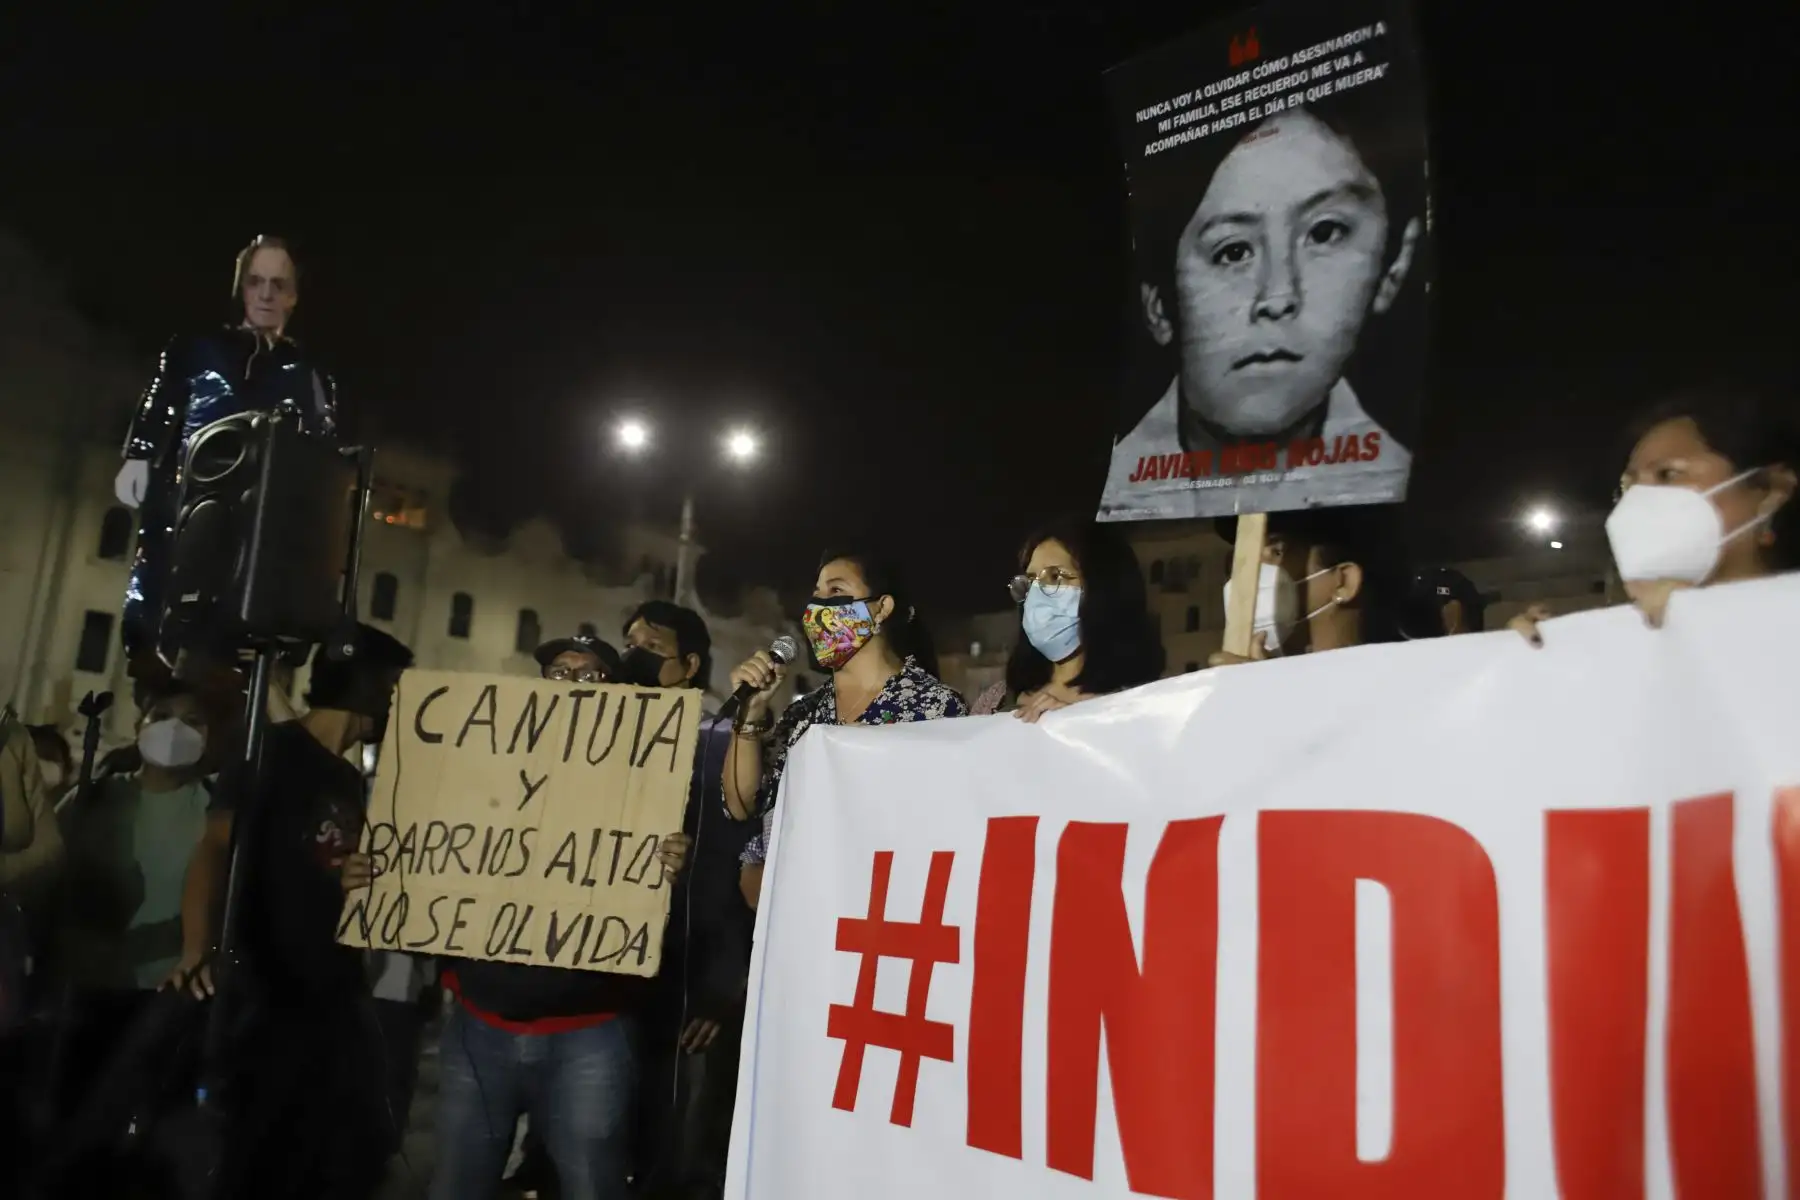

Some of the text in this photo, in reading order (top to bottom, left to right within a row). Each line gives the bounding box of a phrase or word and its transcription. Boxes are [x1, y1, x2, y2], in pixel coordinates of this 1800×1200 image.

[1136, 21, 1387, 123] NUNCA VOY A OLVIDAR CÓMO ASESINARON A
[1158, 51, 1364, 134] MI FAMILIA, ESE RECUERDO ME VA A
[1144, 123, 1209, 157] ACOMPAÑAR
[1211, 112, 1247, 135] HASTA
[1248, 107, 1263, 122] EL
[1265, 97, 1285, 116] DÍA
[1287, 92, 1304, 108] EN
[1306, 82, 1333, 104] QUE
[1129, 451, 1211, 482] JAVIER
[1286, 432, 1381, 469] ROJAS
[414, 684, 686, 773] CANTUTA
[518, 769, 548, 811] Y
[369, 820, 538, 877] BARRIOS
[544, 828, 668, 889] ALTOS
[336, 891, 409, 945] NO
[406, 895, 476, 951] SE
[827, 788, 1800, 1200] #INDU
